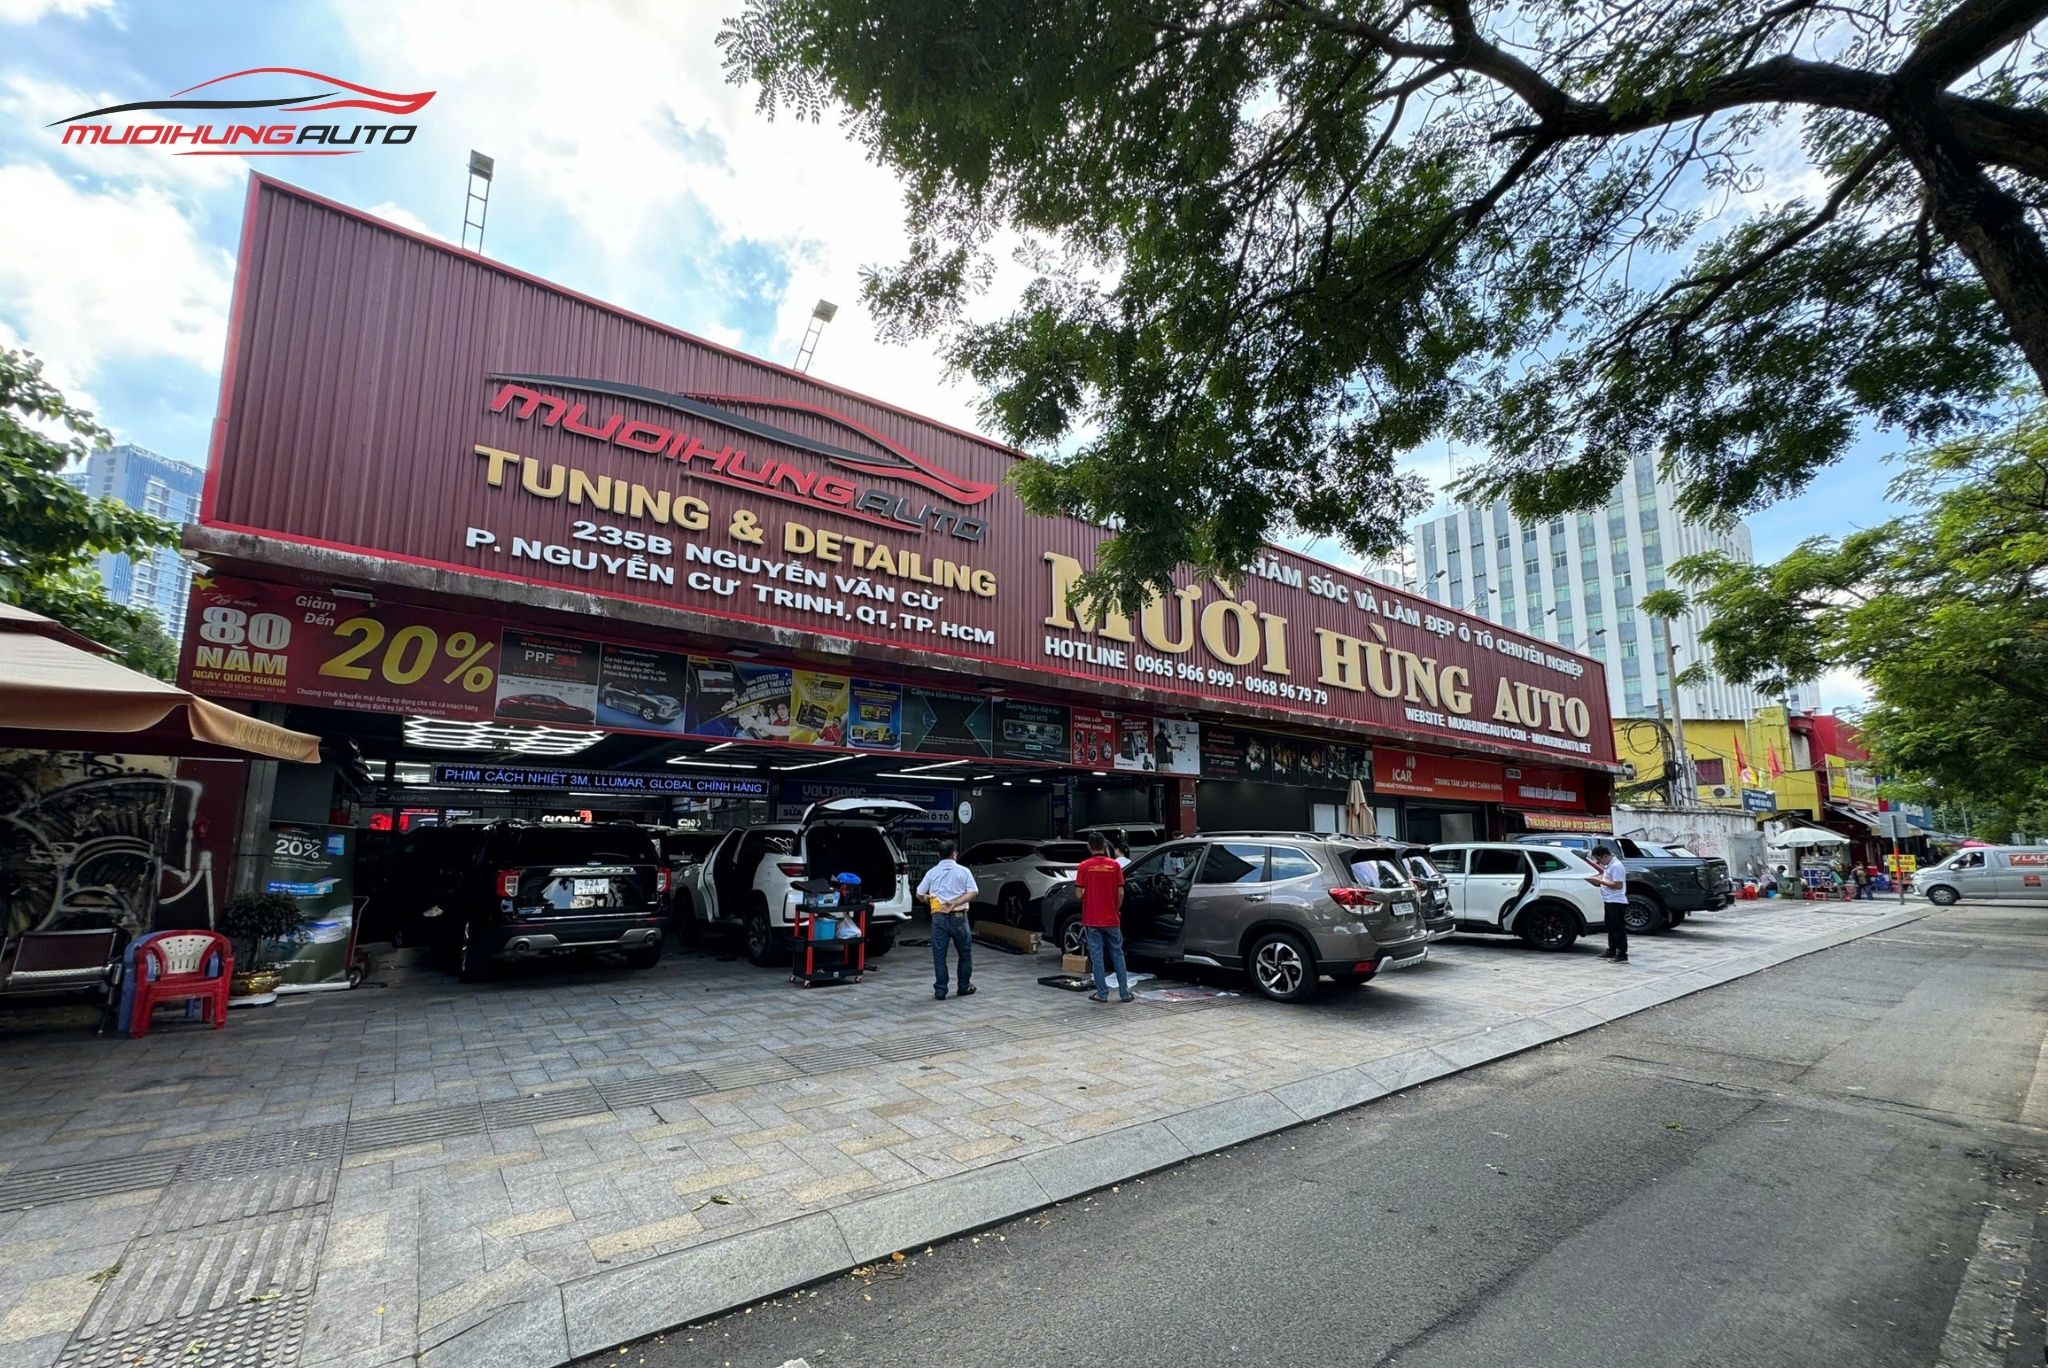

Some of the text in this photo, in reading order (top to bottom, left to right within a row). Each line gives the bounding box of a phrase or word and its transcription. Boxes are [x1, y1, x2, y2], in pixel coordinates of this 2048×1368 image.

[474, 444, 997, 597] TUNING & DETAILING
[466, 527, 501, 552] P.
[512, 537, 674, 585] NGUYỄN
[687, 572, 741, 595] CƯ
[941, 621, 996, 646] HCM
[572, 520, 944, 611] 235B NGUYỄN VĂN CỪ
[295, 595, 337, 611] Giảm
[304, 611, 335, 627] Đến
[200, 606, 292, 650] 80
[1044, 551, 1591, 738] MƯỜI HÙNG AUTO
[1308, 574, 1349, 604] SÓC
[1354, 588, 1379, 614] VÀ
[1382, 599, 1420, 627] LÀM
[1424, 614, 1455, 639] ĐẸP
[1458, 622, 1471, 642] Ô
[1475, 629, 1494, 650] TÔ
[1496, 639, 1544, 666] CHUYÊN
[1546, 654, 1584, 680] NGHIỆP
[195, 644, 288, 677] NĂM
[318, 617, 495, 692] 20%
[524, 650, 555, 664] PPF
[1135, 654, 1174, 677] 0965
[1177, 662, 1205, 683] 966
[1208, 668, 1234, 688] 999
[1245, 675, 1278, 697] 0968
[444, 769, 480, 781] PHIM
[485, 770, 524, 783] CÁCH
[528, 772, 567, 785] NHIỆT
[650, 779, 694, 791] GLOBAL
[696, 780, 730, 792] CHÍNH
[1392, 768, 1413, 783] ICAR
[274, 839, 321, 858] 20%
